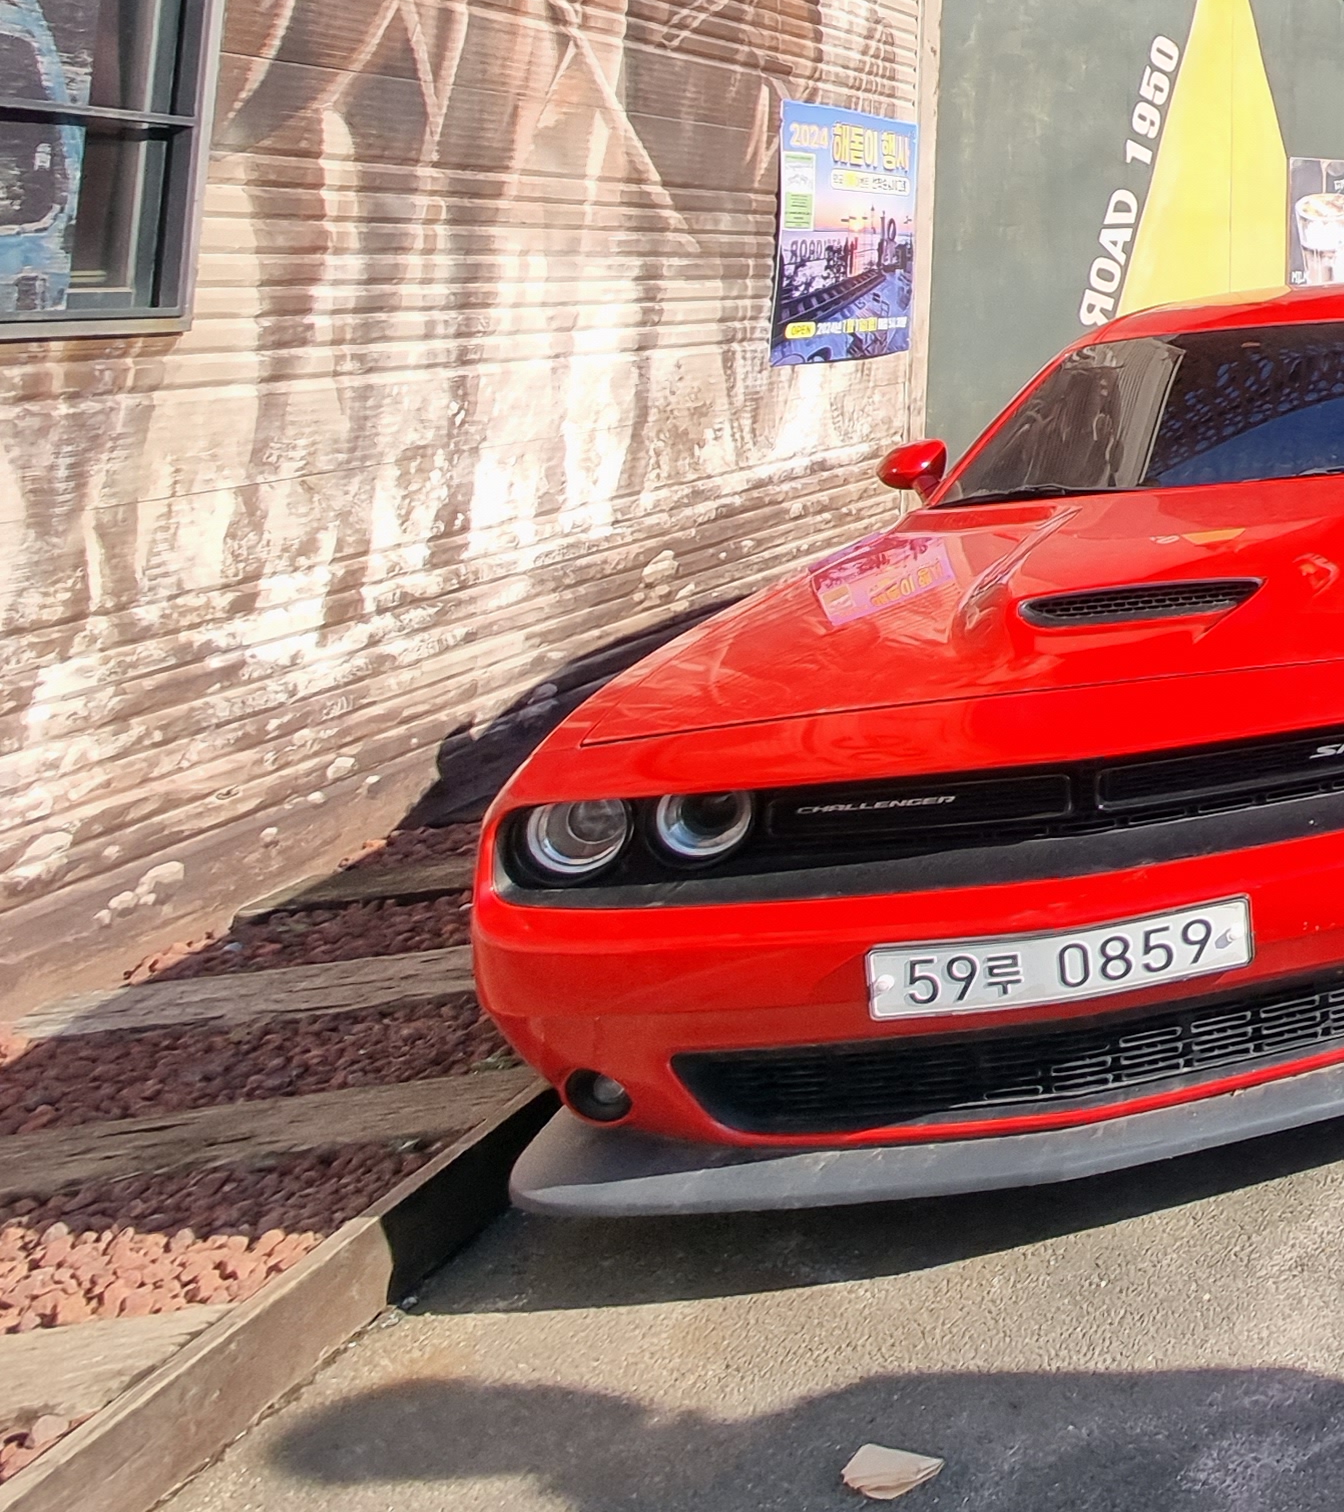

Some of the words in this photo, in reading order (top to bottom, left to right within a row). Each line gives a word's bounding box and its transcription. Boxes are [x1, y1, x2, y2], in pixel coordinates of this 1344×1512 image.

[1125, 35, 1180, 165] 1950
[789, 121, 828, 149] 2024
[832, 121, 878, 169] 해돋이
[881, 131, 911, 173] 행사
[790, 325, 812, 336] OPEN
[796, 795, 956, 815] CHALLENGER
[906, 953, 1023, 1005] 59루
[1058, 919, 1213, 988] 0859
